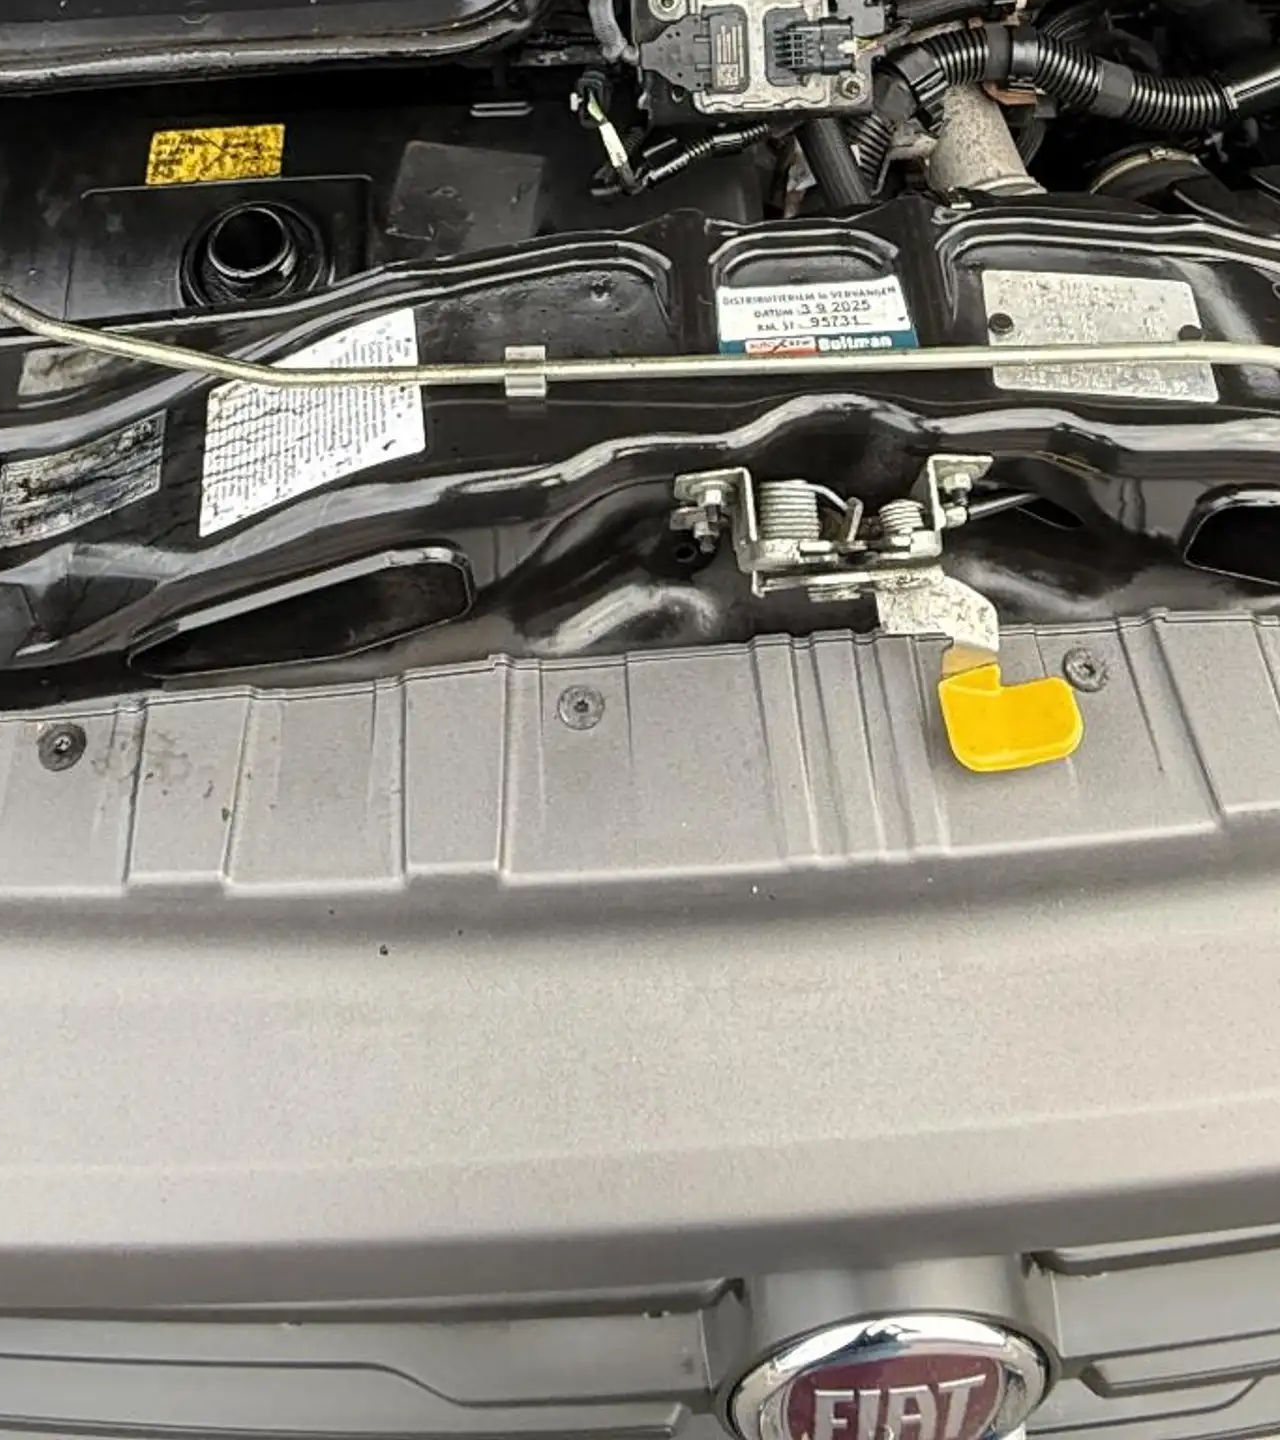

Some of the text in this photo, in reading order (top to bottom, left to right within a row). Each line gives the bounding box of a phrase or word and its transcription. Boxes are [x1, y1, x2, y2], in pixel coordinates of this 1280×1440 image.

[831, 299, 871, 313] 2025
[809, 315, 860, 328] 95731
[814, 1374, 987, 1440] FIAT
